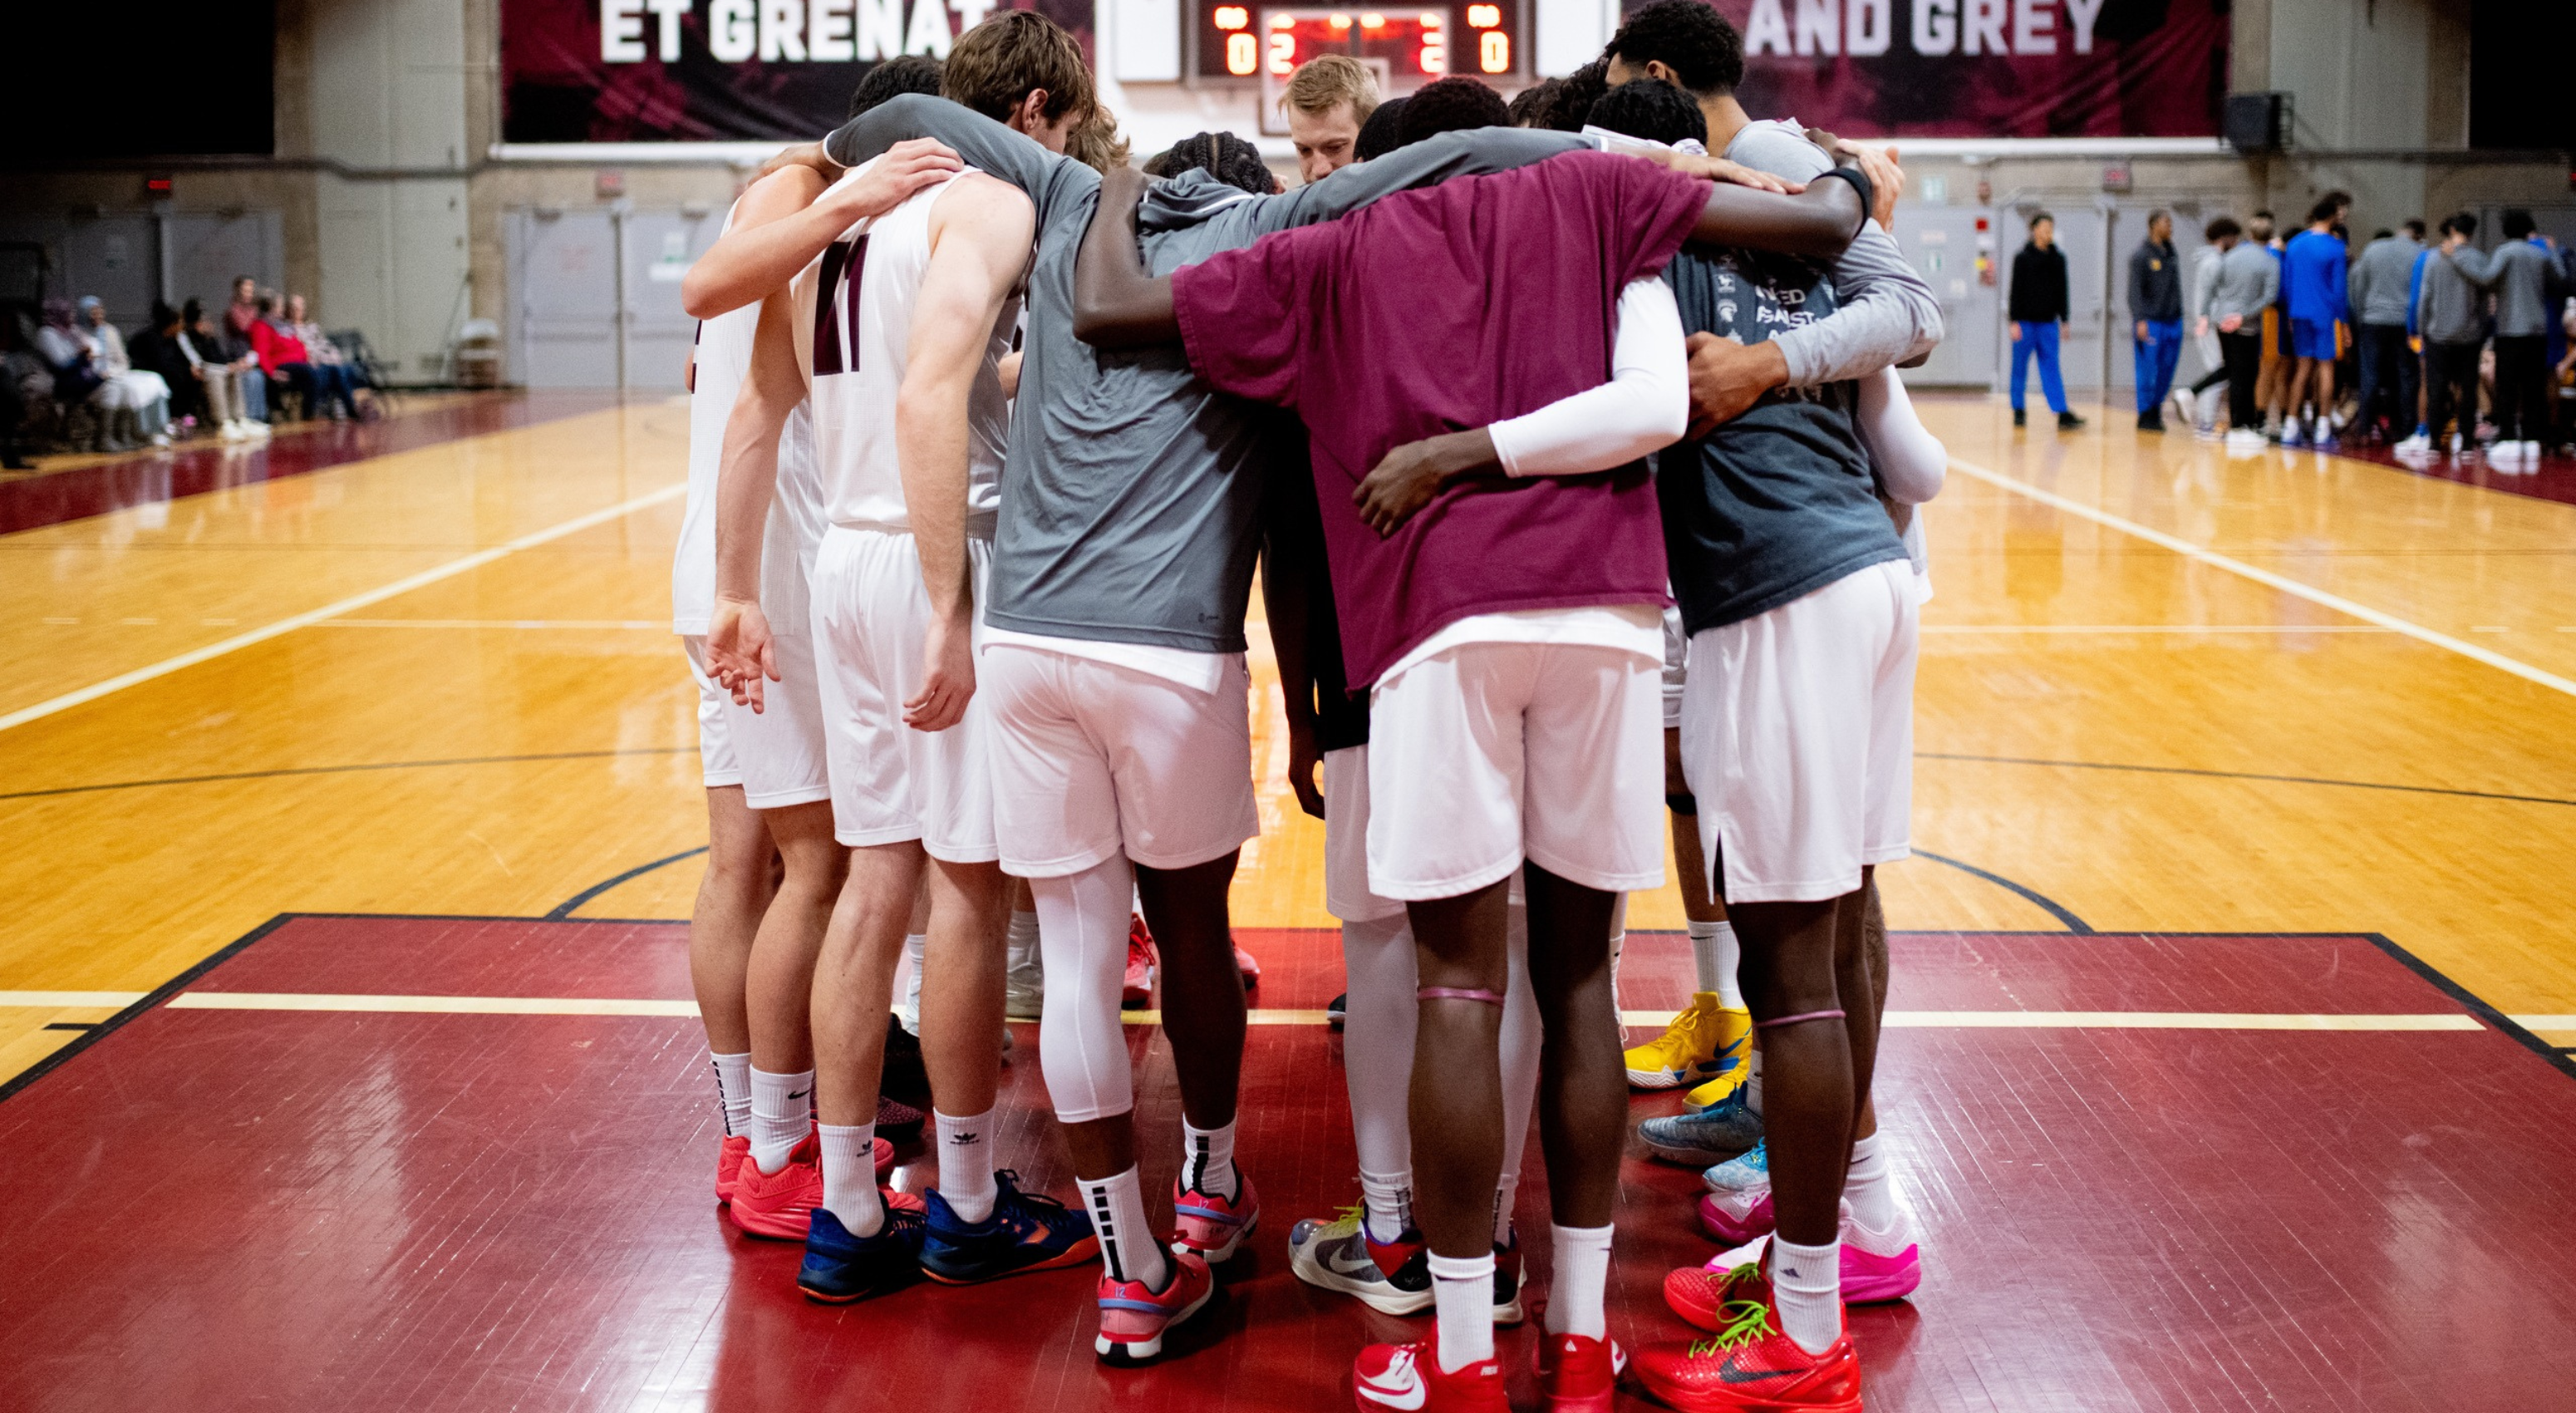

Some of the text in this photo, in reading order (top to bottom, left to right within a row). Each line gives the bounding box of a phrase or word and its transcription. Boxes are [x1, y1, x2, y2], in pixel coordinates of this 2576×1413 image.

[600, 0, 691, 62] ET
[1743, 0, 2102, 57] AND GREY
[1114, 1285, 1126, 1298] 12
